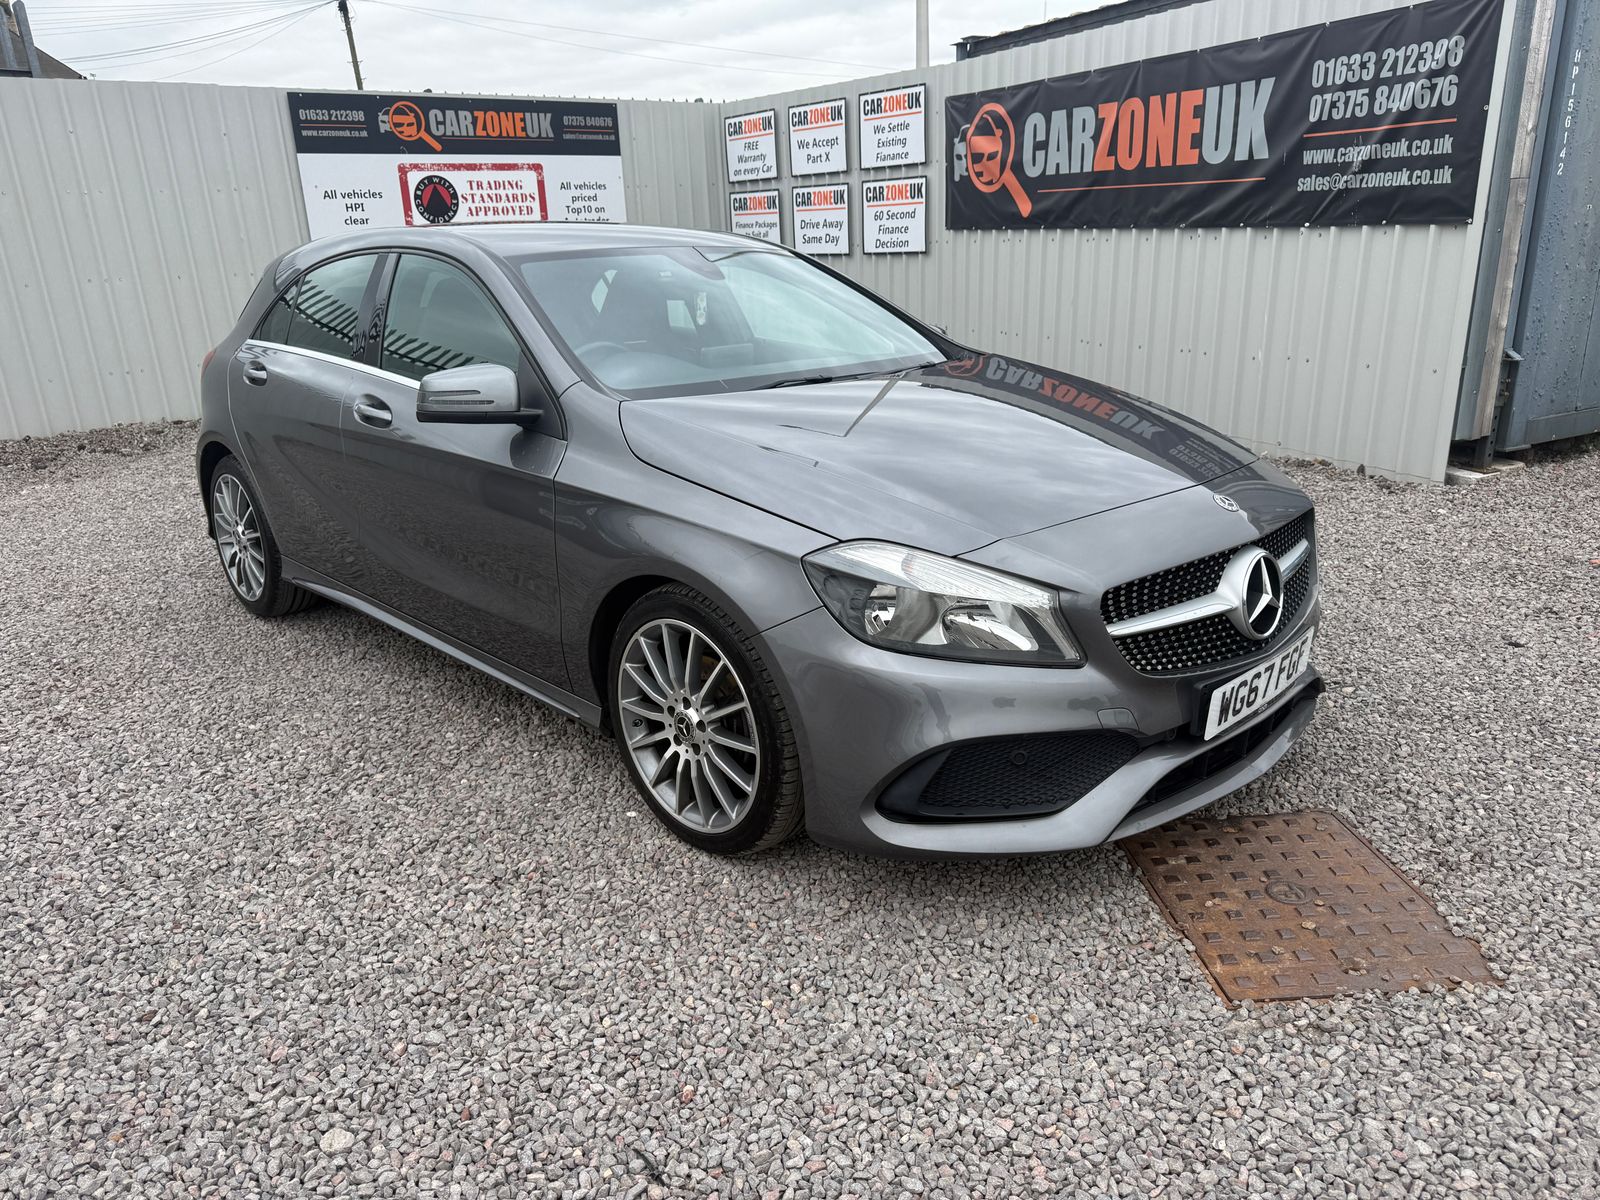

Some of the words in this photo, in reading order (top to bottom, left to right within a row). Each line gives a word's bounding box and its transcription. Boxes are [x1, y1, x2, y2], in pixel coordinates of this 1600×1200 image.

[1312, 51, 1376, 88] 01633
[1380, 35, 1466, 78] 212398
[863, 91, 922, 116] CARZONEUK
[1308, 88, 1370, 123] 07375
[1373, 74, 1458, 116] 840676
[299, 109, 328, 120] 01633
[330, 110, 364, 122] 212398
[792, 104, 843, 128] CARZONEUK
[428, 109, 554, 138] CARZONEUK
[728, 115, 773, 137] CARZONEUK
[874, 124, 886, 135] We
[888, 120, 910, 134] Settle
[1024, 78, 1276, 178] CARZONEUK
[744, 140, 759, 152] FREE
[797, 138, 810, 150] We
[812, 136, 839, 150] Accept
[877, 136, 907, 148] Existing
[1303, 134, 1454, 165] www.carzoneuk.co.uk
[738, 152, 767, 164] Warranty
[806, 154, 822, 164] Part
[824, 152, 830, 162] X
[876, 151, 910, 162] Fianance
[743, 166, 760, 176] every
[762, 164, 773, 174] Car
[1297, 165, 1454, 192] sales@carzoneuk.co.uk
[416, 180, 428, 194] BUY
[432, 177, 454, 194] WITH
[466, 180, 523, 191] TRADING
[560, 181, 572, 190] All
[574, 181, 607, 190] vehicles
[323, 189, 338, 200] All
[340, 188, 384, 200] vehicles
[461, 192, 536, 204] STANDARDS
[571, 192, 598, 204] priced
[795, 189, 846, 208] CARZONEUK
[866, 182, 924, 203] CARZONEUK
[345, 202, 366, 212] HPI
[565, 204, 592, 216] Top10
[732, 195, 778, 212] CARZONEUK
[466, 206, 534, 216] APPROVED
[874, 210, 884, 222] 60
[886, 208, 916, 220] Second
[344, 216, 370, 226] clear
[736, 221, 754, 229] Finance
[754, 220, 778, 230] Packages
[800, 218, 820, 230] Drive
[822, 218, 844, 232] Away
[878, 224, 909, 235] Finance
[802, 234, 822, 244] Same
[824, 233, 840, 246] Day
[875, 237, 910, 248] Decision
[1218, 662, 1276, 727] WG67
